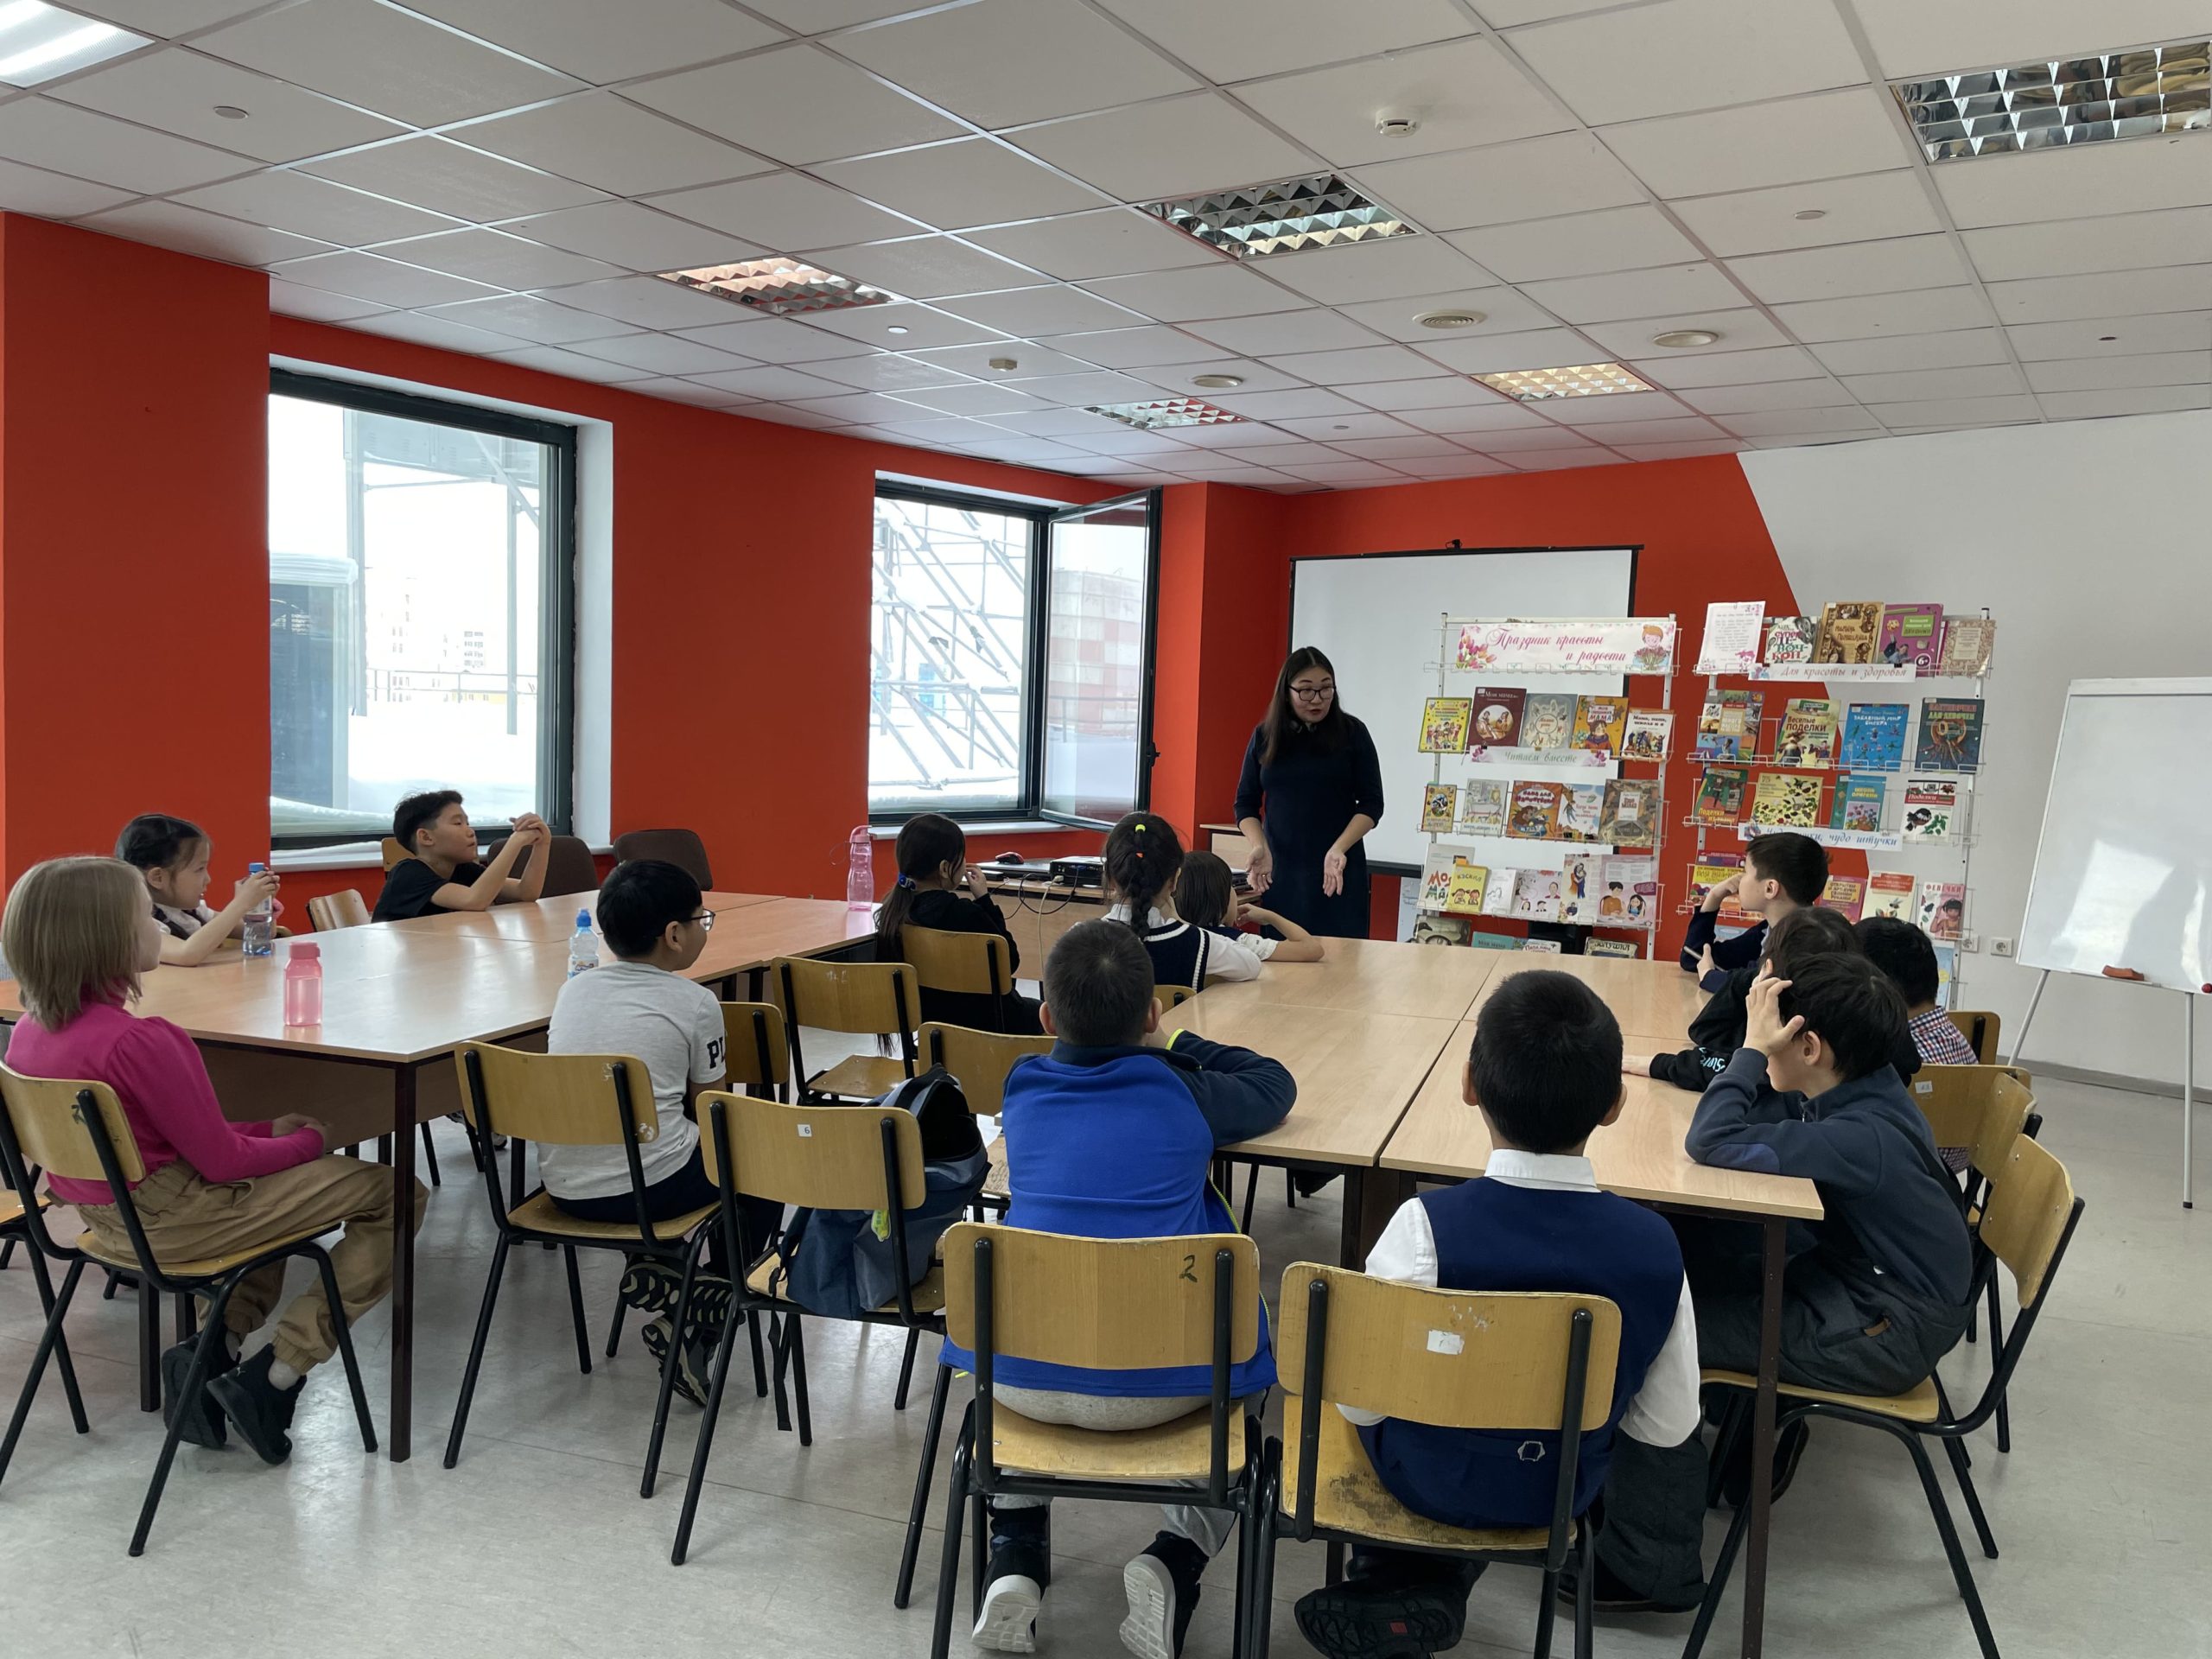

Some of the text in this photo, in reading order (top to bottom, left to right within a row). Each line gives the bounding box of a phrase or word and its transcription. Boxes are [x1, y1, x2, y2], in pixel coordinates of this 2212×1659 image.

[1485, 627, 1604, 651] Праздник красоты
[1566, 651, 1627, 665] и радости
[1917, 657, 1929, 665] 6+
[1780, 666, 1907, 683] Для красоты и здоровья
[1788, 715, 1815, 724] Веселые
[1786, 724, 1827, 733] поделки
[1504, 750, 1578, 764] Читаем вместе
[1698, 807, 1725, 817] Поделки
[1828, 833, 1851, 847] чудо
[1855, 835, 1897, 849] штучки
[1425, 884, 1451, 906] Ма
[1179, 1255, 1198, 1283] 2
